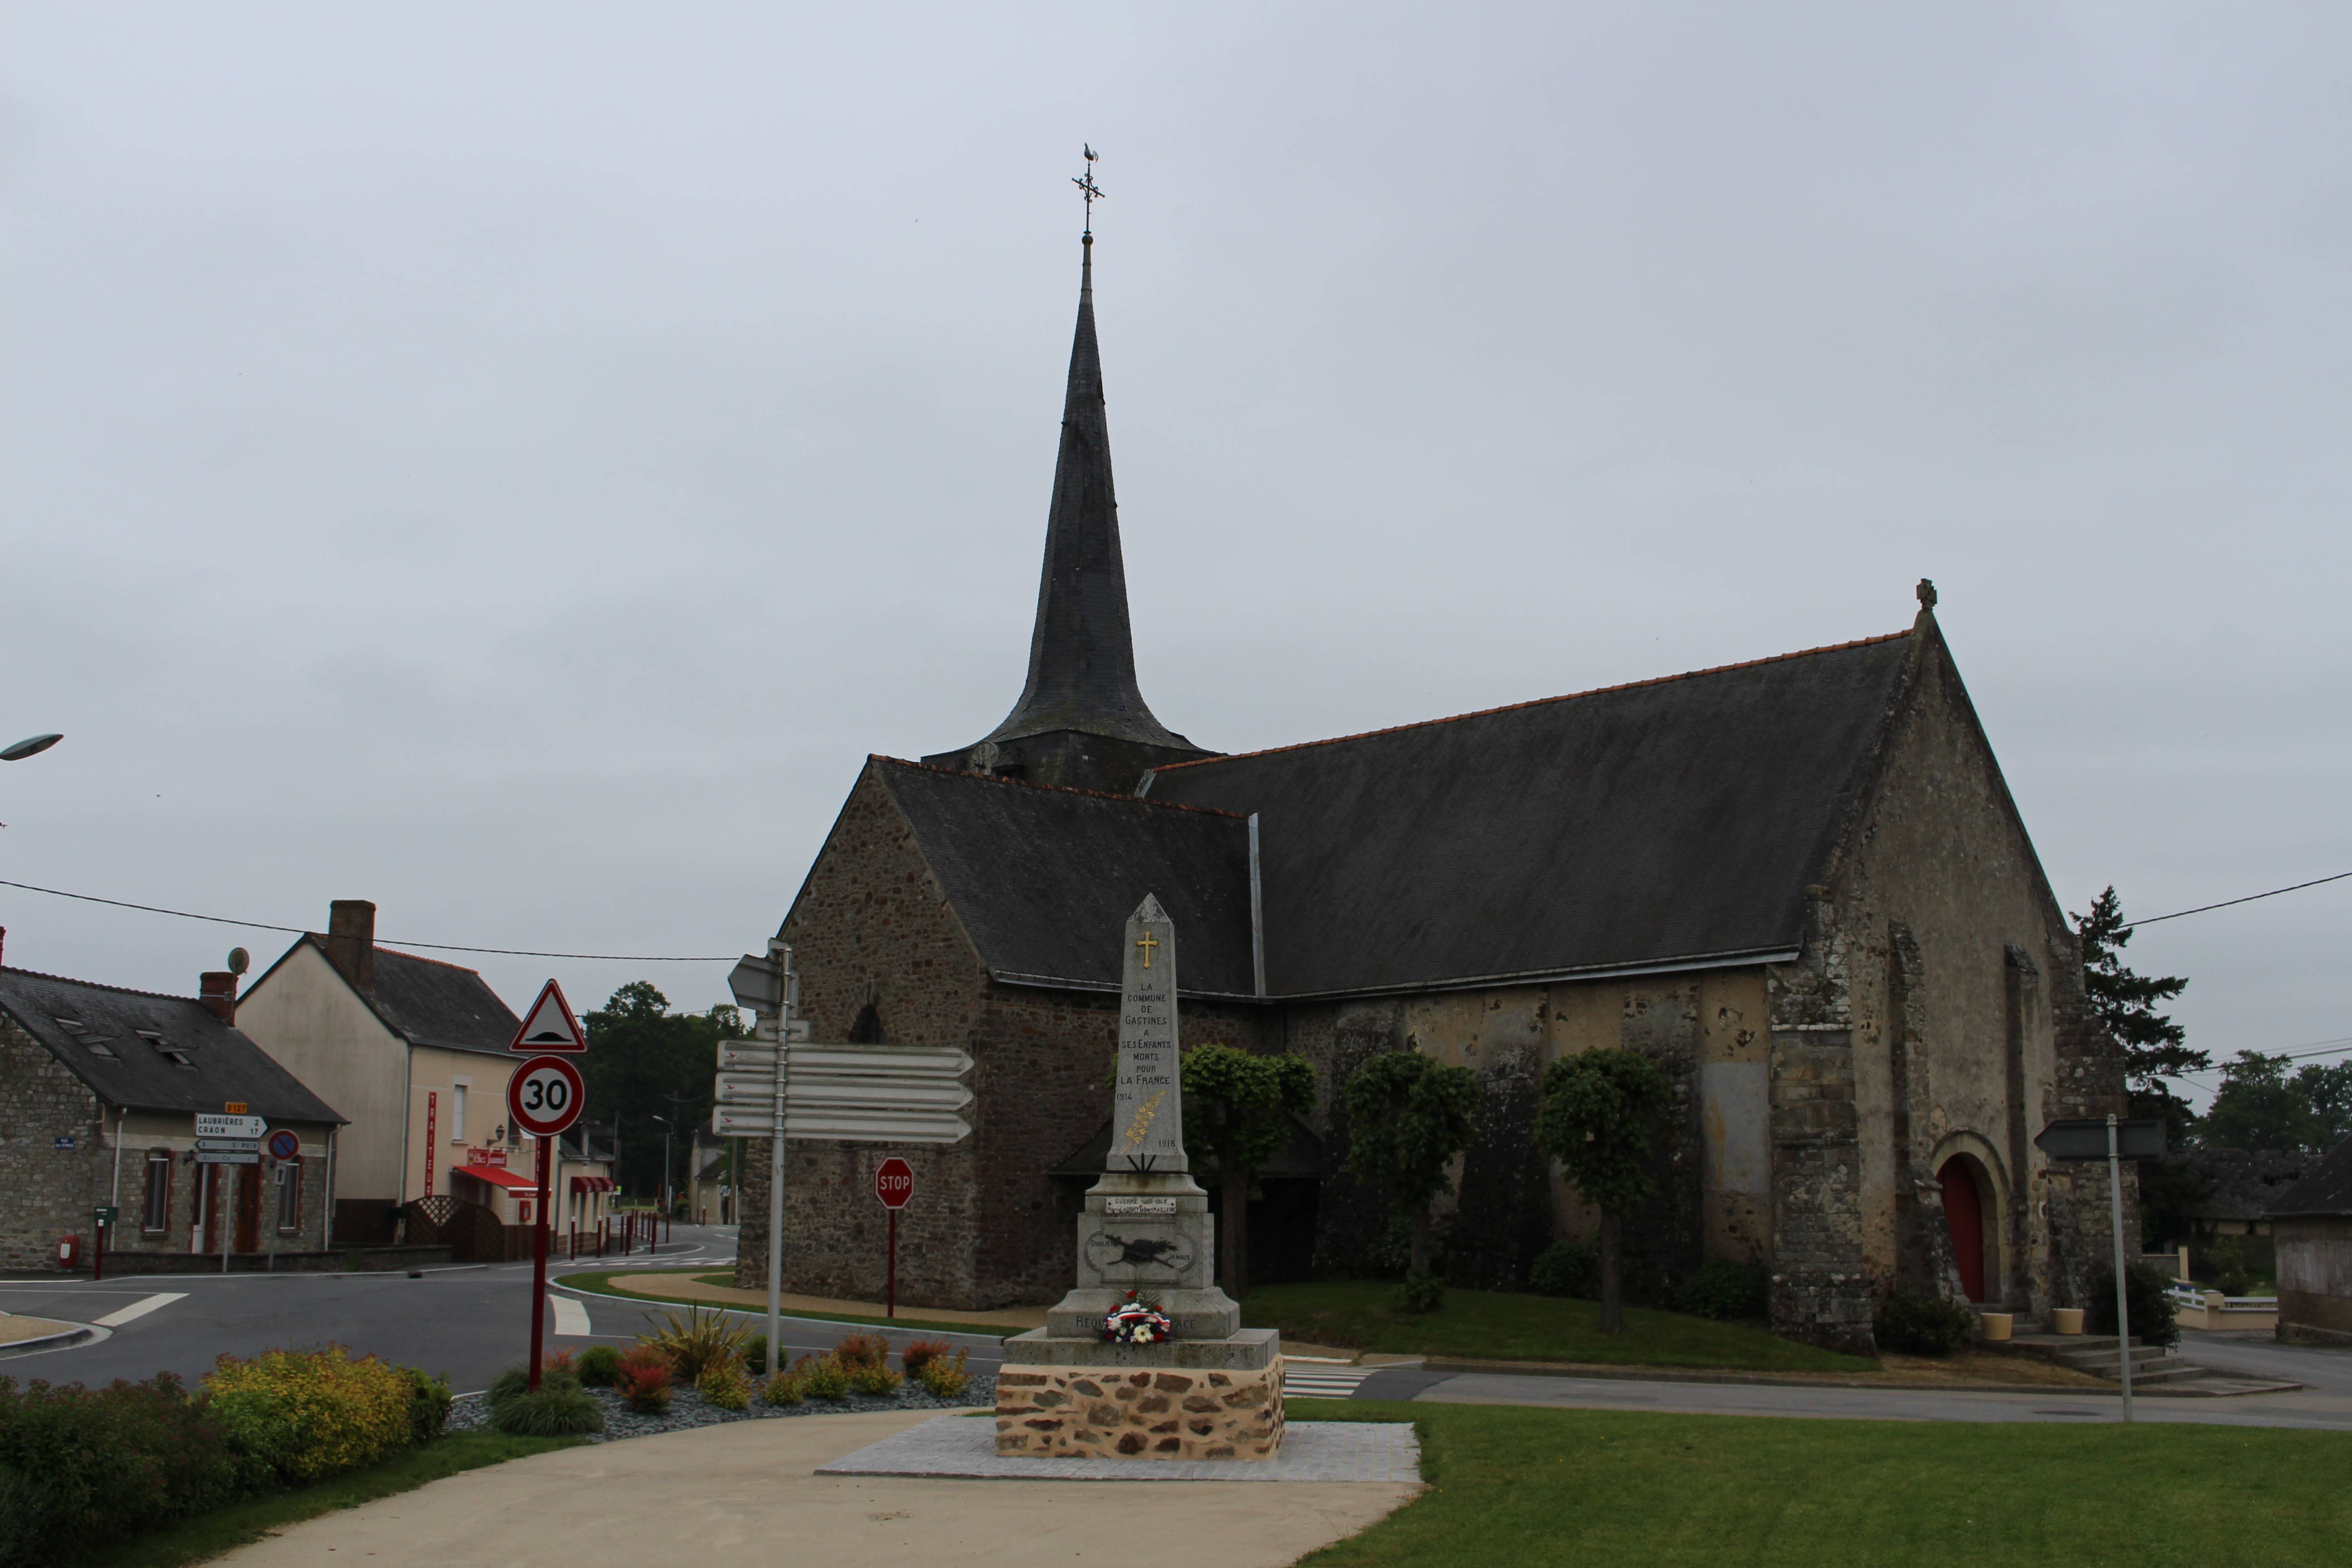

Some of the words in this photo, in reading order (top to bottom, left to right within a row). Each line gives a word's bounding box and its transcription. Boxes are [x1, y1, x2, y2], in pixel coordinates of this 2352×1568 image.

[1125, 1015, 1167, 1025] GASTINES
[1138, 1039, 1171, 1049] ENFANTS
[1136, 1075, 1171, 1084] FRANCE
[524, 1079, 567, 1111] 30
[198, 1117, 244, 1125] LAUBRIÈRES
[427, 1095, 435, 1194] TRAITEUR
[880, 1176, 910, 1190] STOP
[1168, 1253, 1190, 1261] JAMAIS
